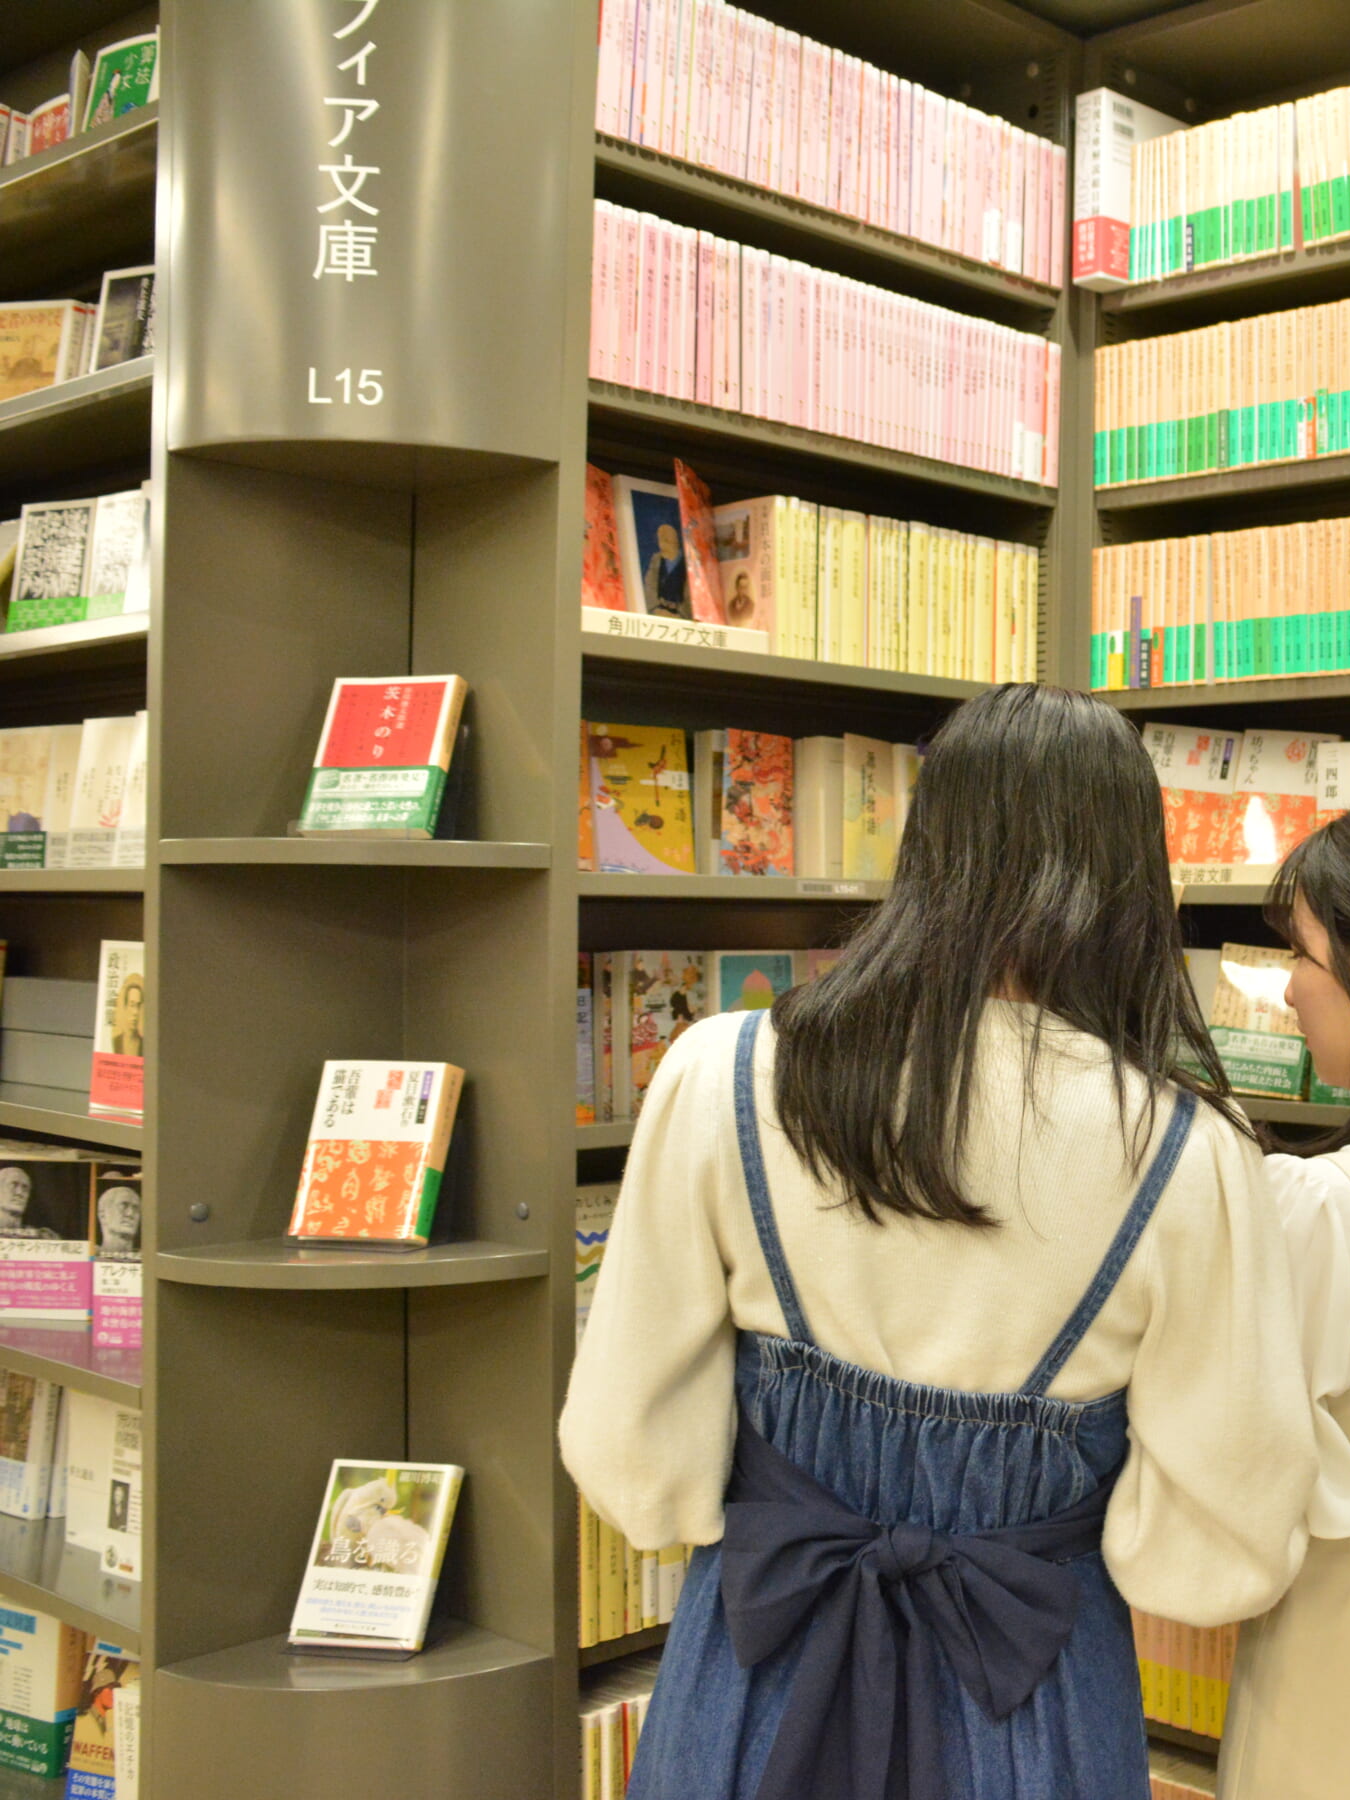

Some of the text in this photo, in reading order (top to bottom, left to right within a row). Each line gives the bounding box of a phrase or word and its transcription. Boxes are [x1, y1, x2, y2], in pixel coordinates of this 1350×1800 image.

[307, 367, 384, 405] L15
[608, 615, 728, 648] 角川ソフィア文庫
[1325, 750, 1338, 798] 三四郎
[1180, 868, 1233, 884] 岩波文庫
[323, 1536, 418, 1566] 鳥を識る
